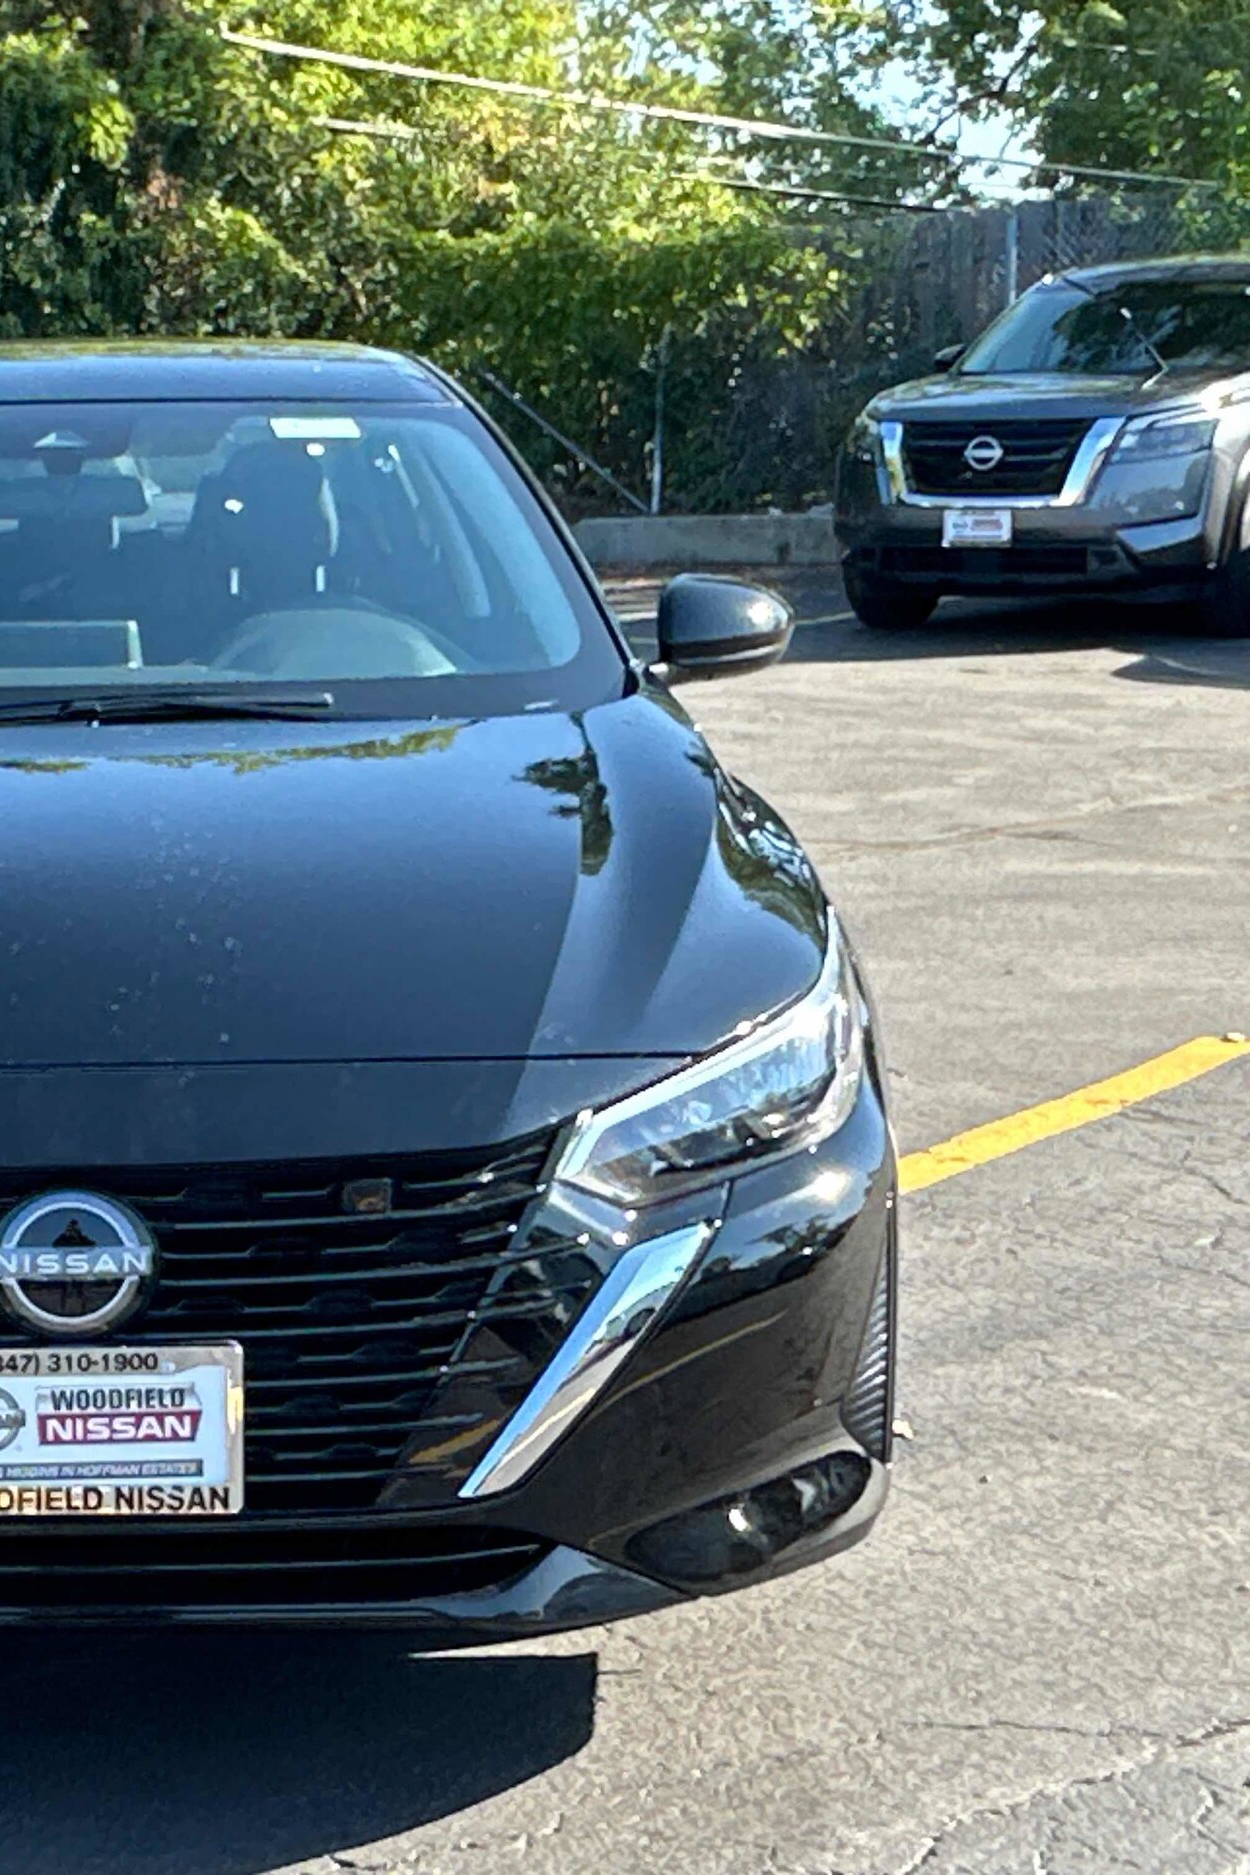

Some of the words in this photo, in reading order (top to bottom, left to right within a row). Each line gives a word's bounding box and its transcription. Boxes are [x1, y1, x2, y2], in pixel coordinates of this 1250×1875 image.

[48, 1352, 159, 1372] 310-1900
[50, 1387, 186, 1411] WOODFIELD
[44, 1414, 193, 1442] NISSAN
[60, 1465, 75, 1477] IN
[76, 1463, 140, 1477] HOFFMAN
[141, 1462, 198, 1475] ESTATES
[114, 1484, 230, 1511] NISSAN
